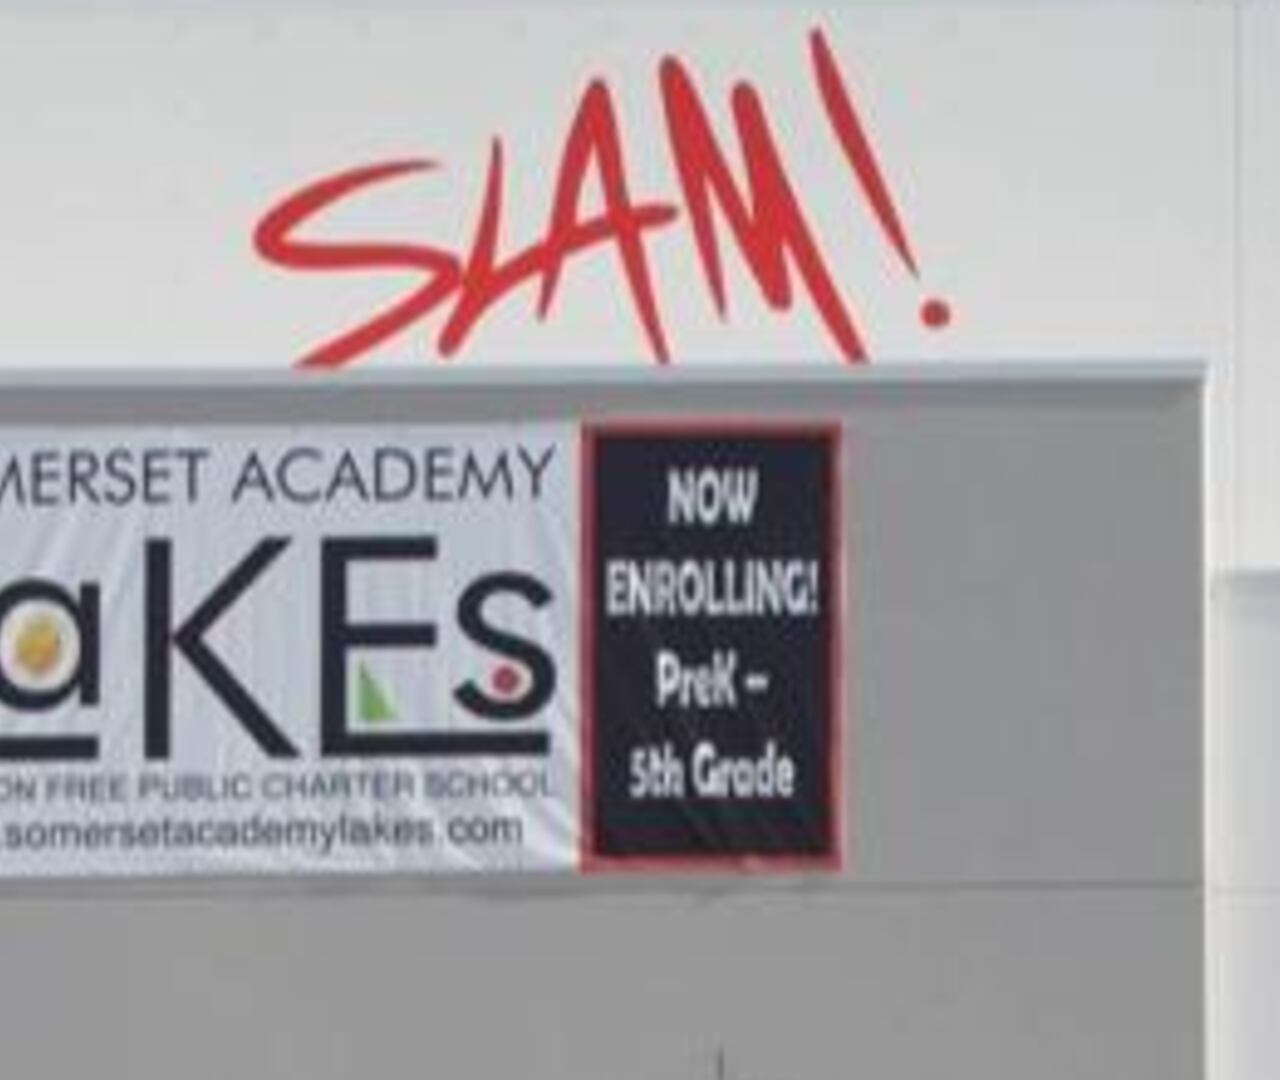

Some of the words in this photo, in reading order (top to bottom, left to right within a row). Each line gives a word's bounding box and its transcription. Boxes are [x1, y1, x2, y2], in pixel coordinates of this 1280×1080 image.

[252, 28, 950, 368] SLAM!
[230, 446, 556, 504] ACADEMY
[668, 467, 758, 524] NOW
[606, 559, 819, 616] ENROLLING!
[655, 649, 738, 707] PreK
[45, 773, 127, 801] FREE
[138, 772, 251, 800] PUBLIC
[261, 771, 415, 799] CHARTER
[423, 771, 551, 799] SCHOOL
[630, 742, 683, 798] 5th
[692, 740, 794, 798] Grade
